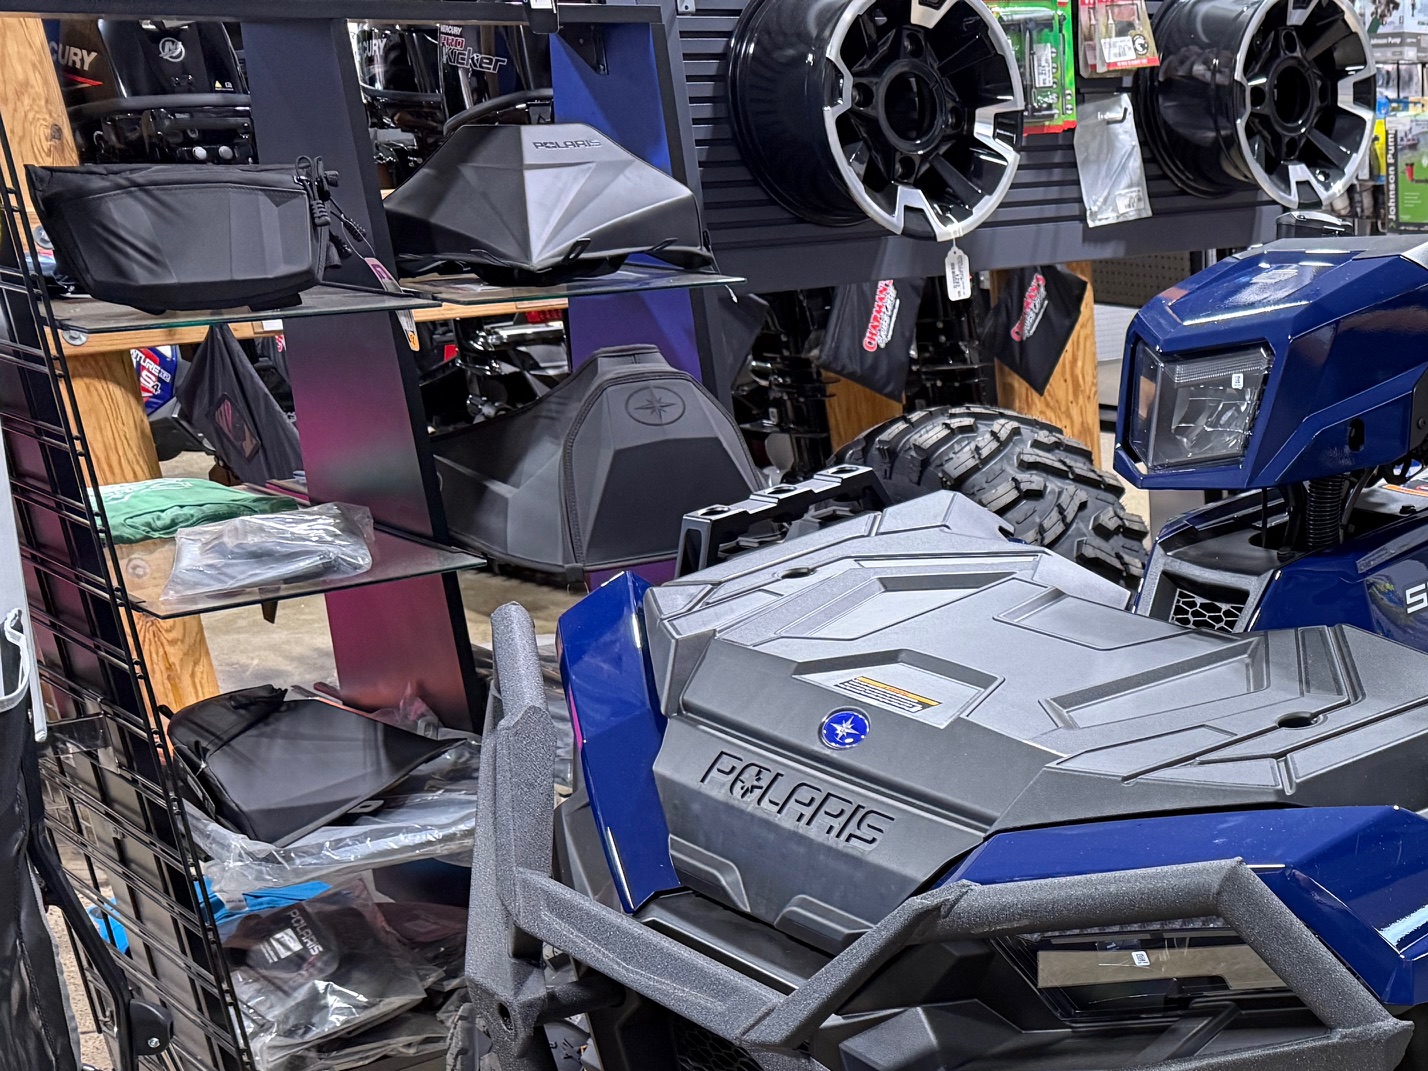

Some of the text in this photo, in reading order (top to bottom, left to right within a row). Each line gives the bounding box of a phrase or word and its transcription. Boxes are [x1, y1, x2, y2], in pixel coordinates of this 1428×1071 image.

[440, 34, 466, 50] PRO
[532, 138, 602, 150] POLARIS
[1387, 165, 1397, 221] Johnson
[699, 750, 896, 846] POLARIS
[287, 908, 325, 956] POLARIS
